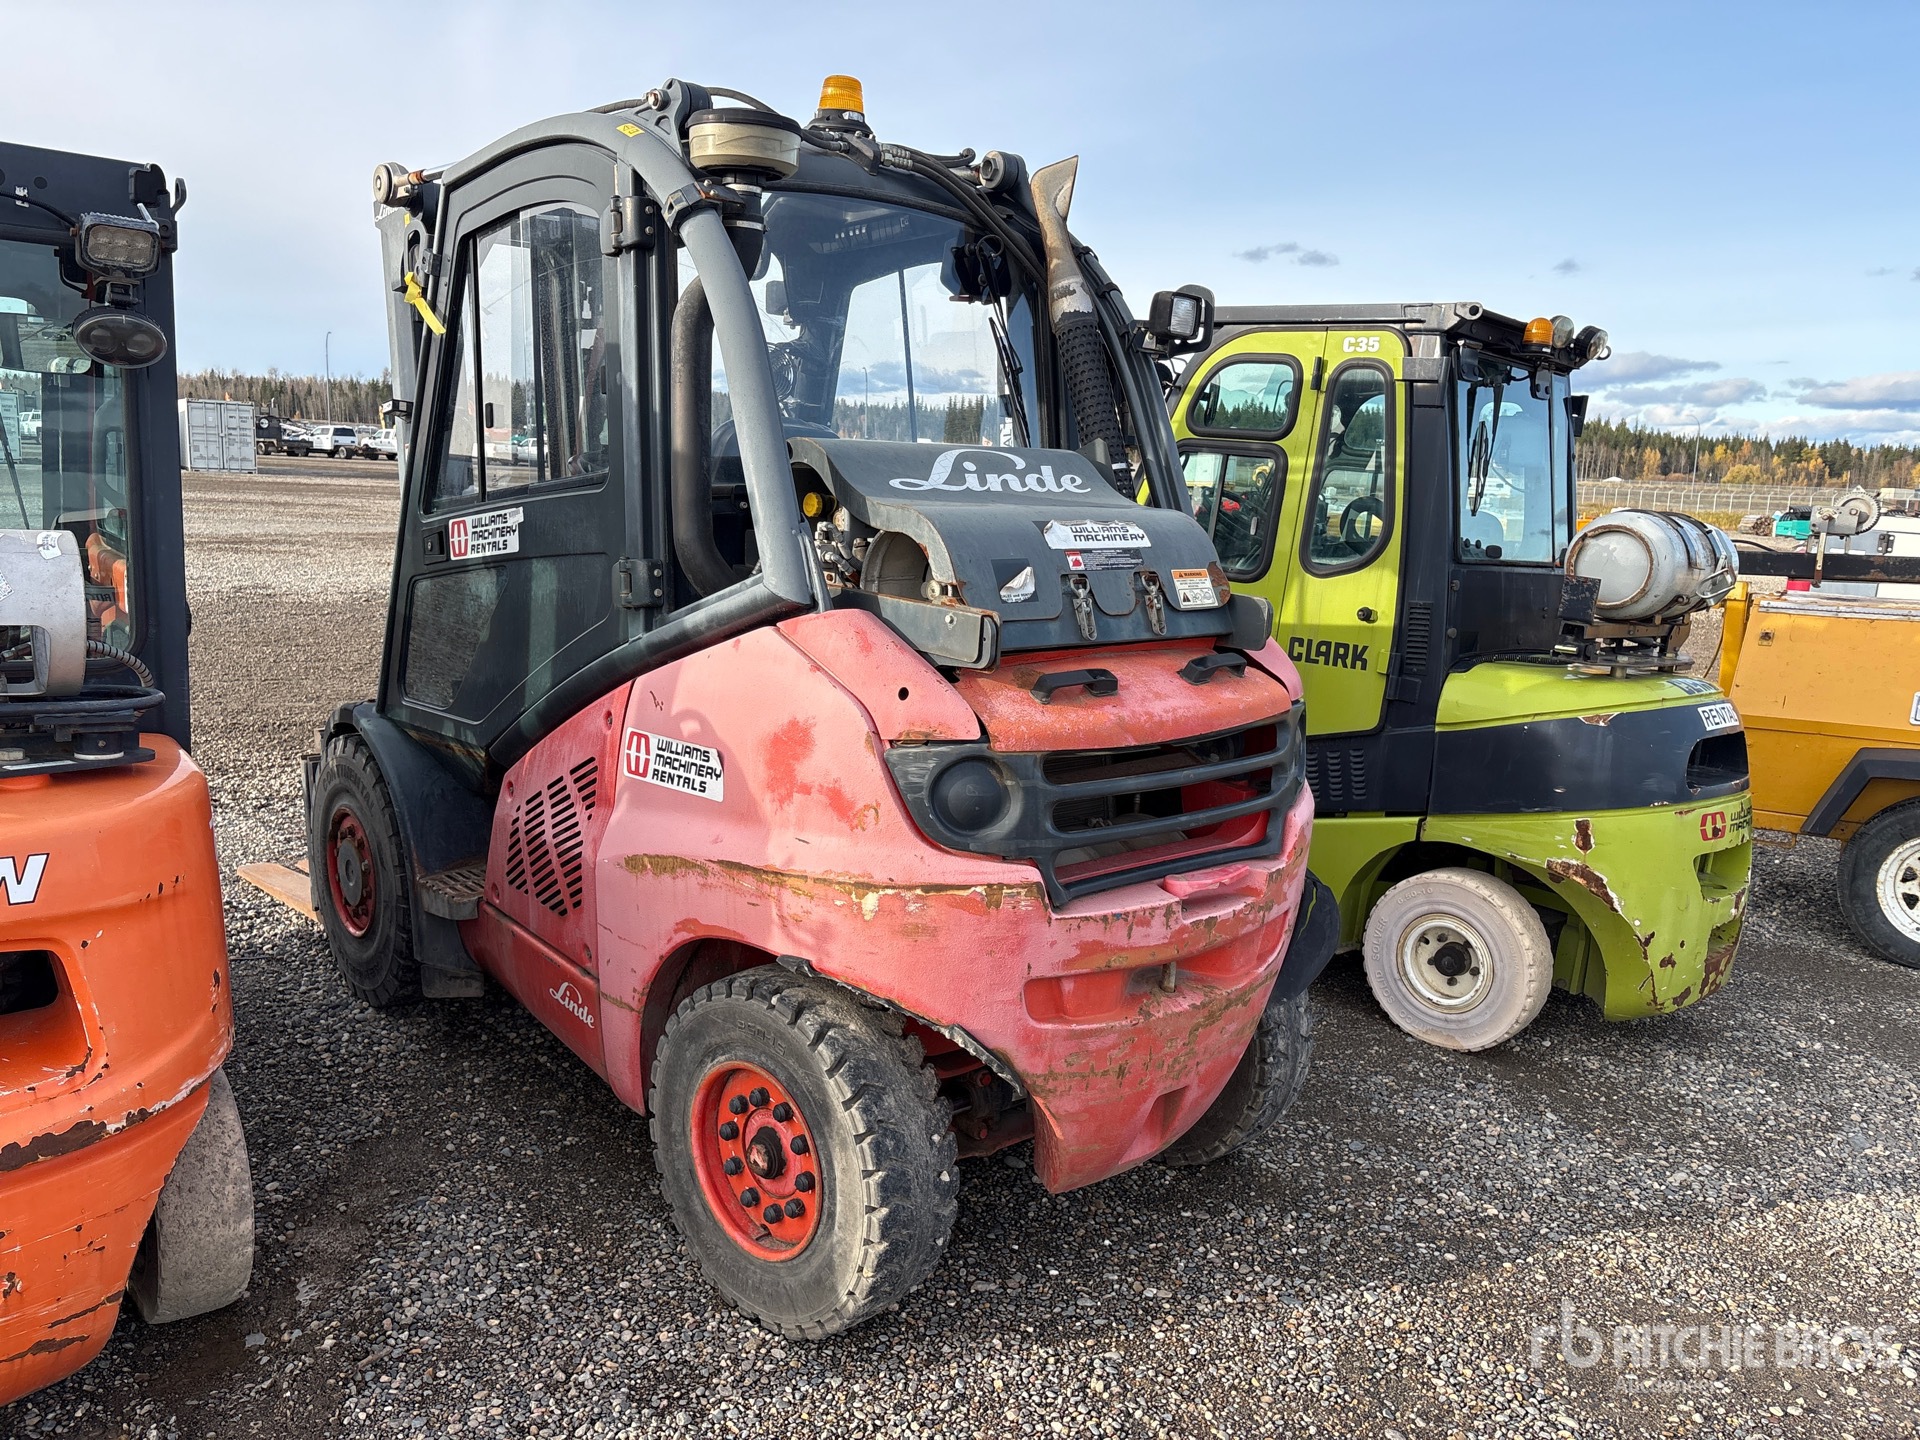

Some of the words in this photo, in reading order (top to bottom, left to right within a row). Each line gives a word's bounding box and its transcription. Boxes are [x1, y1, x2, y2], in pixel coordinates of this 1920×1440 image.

[1343, 336, 1380, 353] C35
[888, 448, 1092, 494] Linde
[472, 512, 508, 529] WILLIAMS
[1070, 526, 1129, 534] WILLIAMS
[471, 523, 517, 542] MACHINERY
[1073, 533, 1145, 542] MACHINERY
[471, 539, 508, 555] RENTALS
[1288, 636, 1370, 671] CLARK
[656, 738, 710, 763] WILLIAMS
[654, 753, 722, 781] MACHINERY
[652, 768, 707, 793] RENTALS
[549, 981, 595, 1029] Linde
